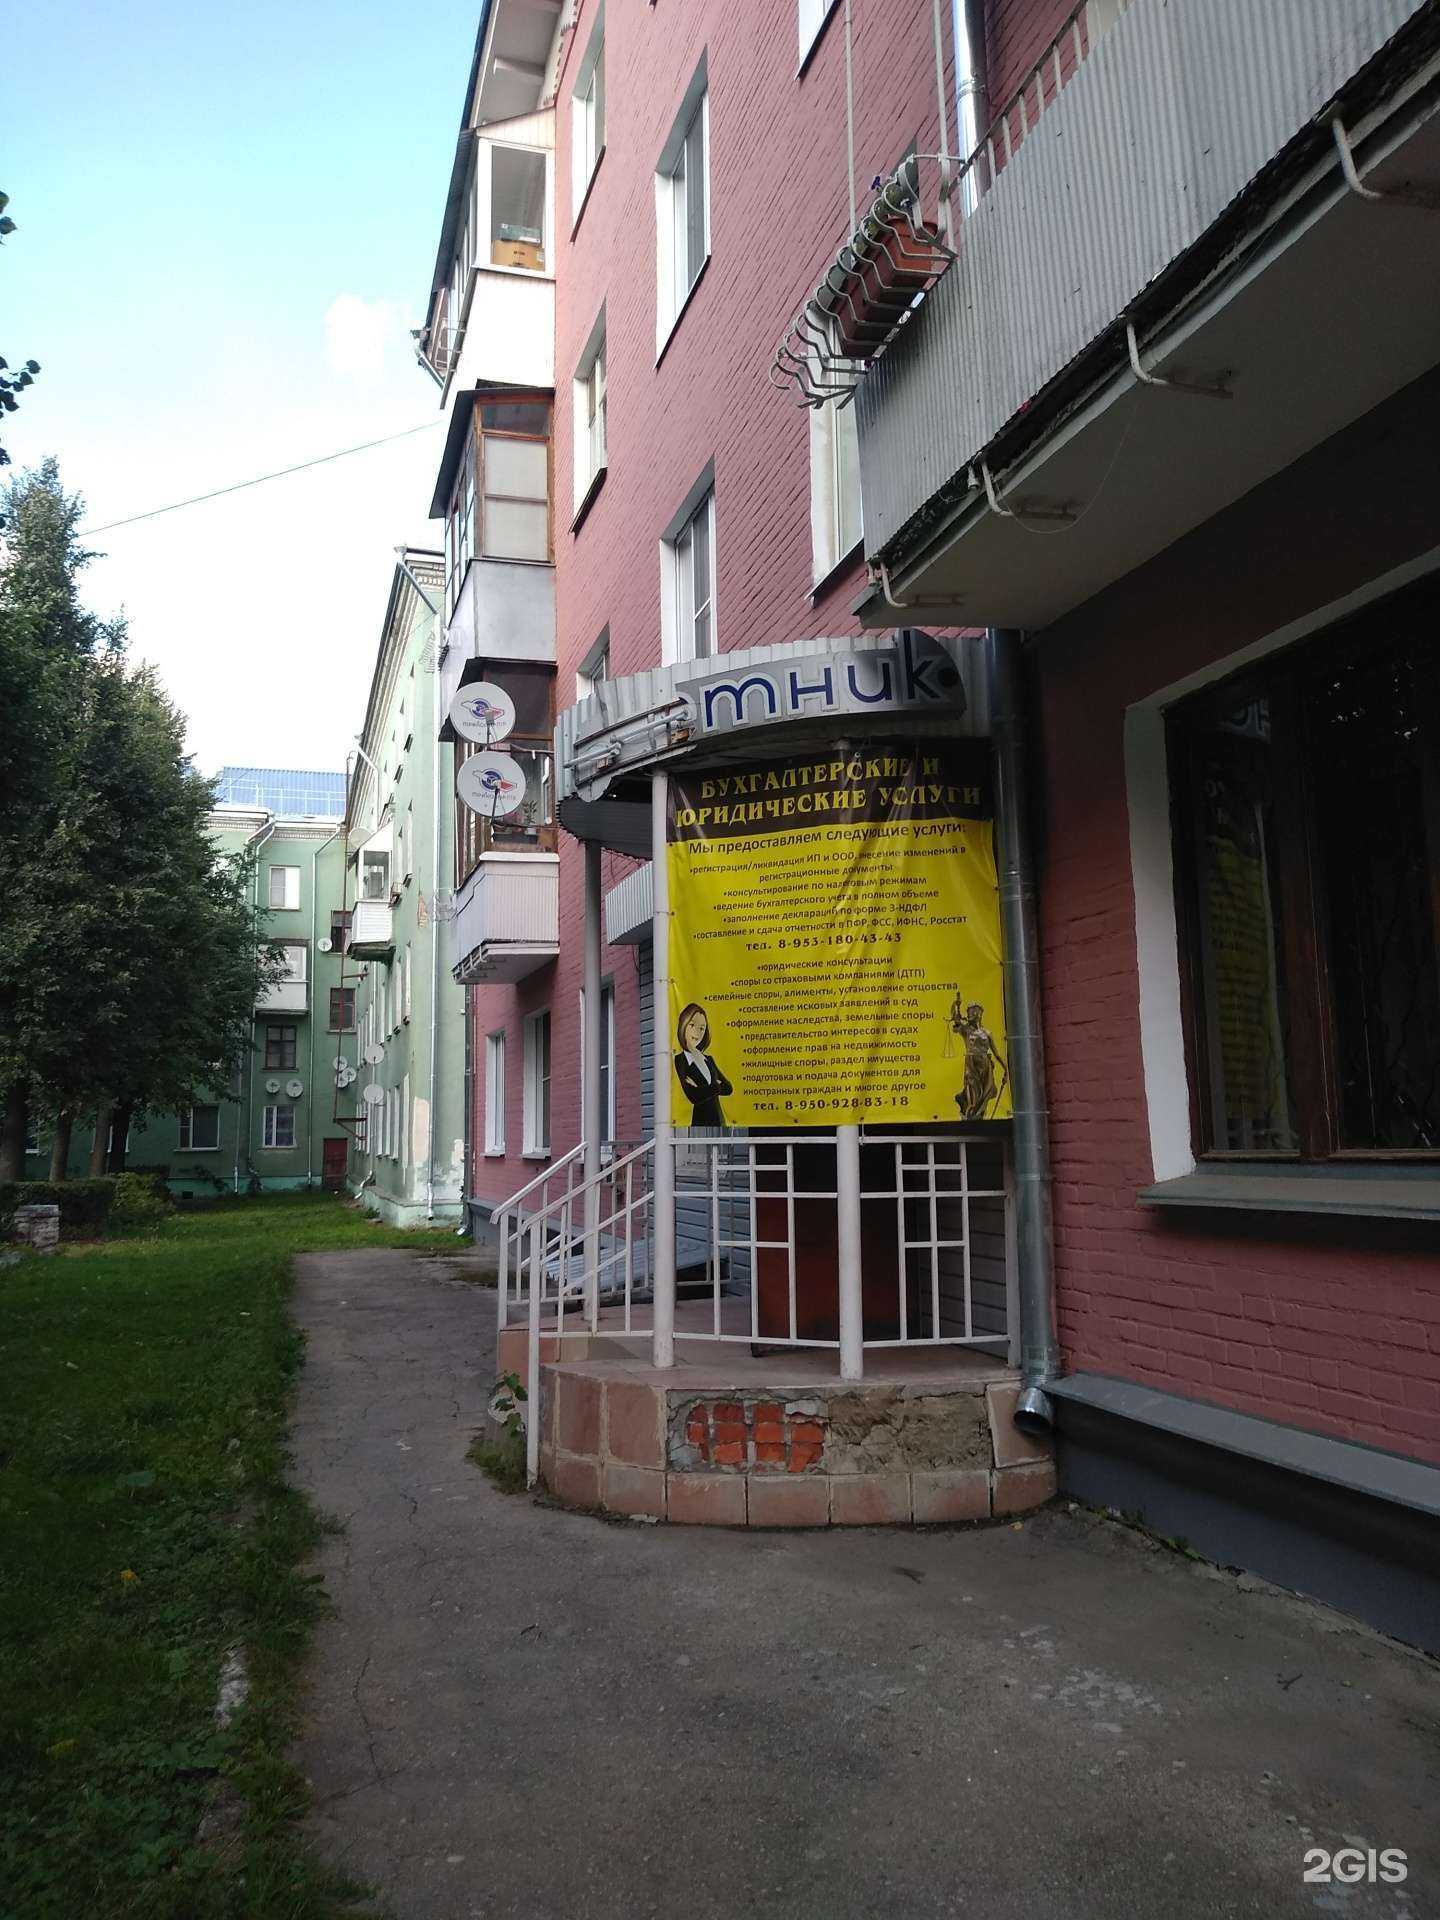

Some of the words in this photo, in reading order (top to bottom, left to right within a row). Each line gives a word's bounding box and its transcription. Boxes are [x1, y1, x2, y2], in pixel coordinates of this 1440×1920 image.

[701, 758, 912, 799] БУХГАЛТЕРСКИЕ
[922, 758, 939, 775] И
[676, 790, 867, 827] ЮРИДИЧЕСКИЕ
[878, 784, 981, 806] УСЛУГИ
[689, 843, 713, 854] Мы
[718, 831, 821, 854] предоставляем
[826, 826, 909, 841] следующие
[913, 823, 966, 838] услуги:
[807, 854, 821, 862] ИП
[904, 847, 958, 857] изменений
[759, 868, 839, 883] регистрационные
[727, 885, 810, 897] консультирование
[880, 877, 927, 885] режимам
[716, 902, 754, 911] ведение
[757, 895, 826, 909] бухгалтерского
[726, 914, 780, 924] заполнение
[696, 930, 747, 940] составление
[757, 926, 782, 935] сдача
[784, 922, 835, 932] отчетности
[871, 918, 894, 928] ФСС,
[896, 917, 927, 927] ИФНС,
[930, 915, 967, 925] Росстат
[745, 941, 771, 951] тел.
[778, 932, 901, 948] 8-953-180-43-43
[761, 960, 823, 972] юридические
[826, 957, 893, 967] консультации
[734, 978, 761, 987] споры
[774, 973, 831, 985] страховыми
[834, 971, 895, 980] компаниями
[897, 968, 925, 978] (ДТП)
[708, 991, 751, 1001] семейные
[754, 991, 782, 1000] споры,
[784, 987, 836, 997] алименты,
[838, 985, 904, 994] установление
[907, 982, 958, 992] отцовства
[742, 1004, 794, 1013] составление
[797, 1001, 836, 1010] исковых
[839, 996, 891, 1008] заявлений
[901, 998, 918, 1007] суд
[730, 1019, 784, 1028] оформление
[788, 1015, 842, 1025] наследства,
[845, 1012, 900, 1021] земельные
[902, 1011, 934, 1020] споры
[745, 1030, 828, 1041] представительство
[890, 1026, 918, 1035] судах
[747, 1046, 802, 1055] оформление
[805, 1044, 828, 1053] прав
[844, 1041, 917, 1050] недвижимость
[745, 1060, 793, 1068] жилищные
[794, 1058, 828, 1067] споры,
[831, 1057, 864, 1066] раздел
[867, 1055, 920, 1063] имущества
[746, 1074, 793, 1082] подготовка
[805, 1072, 838, 1081] подача
[841, 1069, 899, 1079] документов
[901, 1069, 920, 1077] для
[743, 1086, 800, 1096] иностранных
[802, 1085, 841, 1094] граждан
[890, 1083, 926, 1092] другое
[753, 1102, 779, 1111] тел.
[785, 1096, 909, 1111] 8-950-928-83-18
